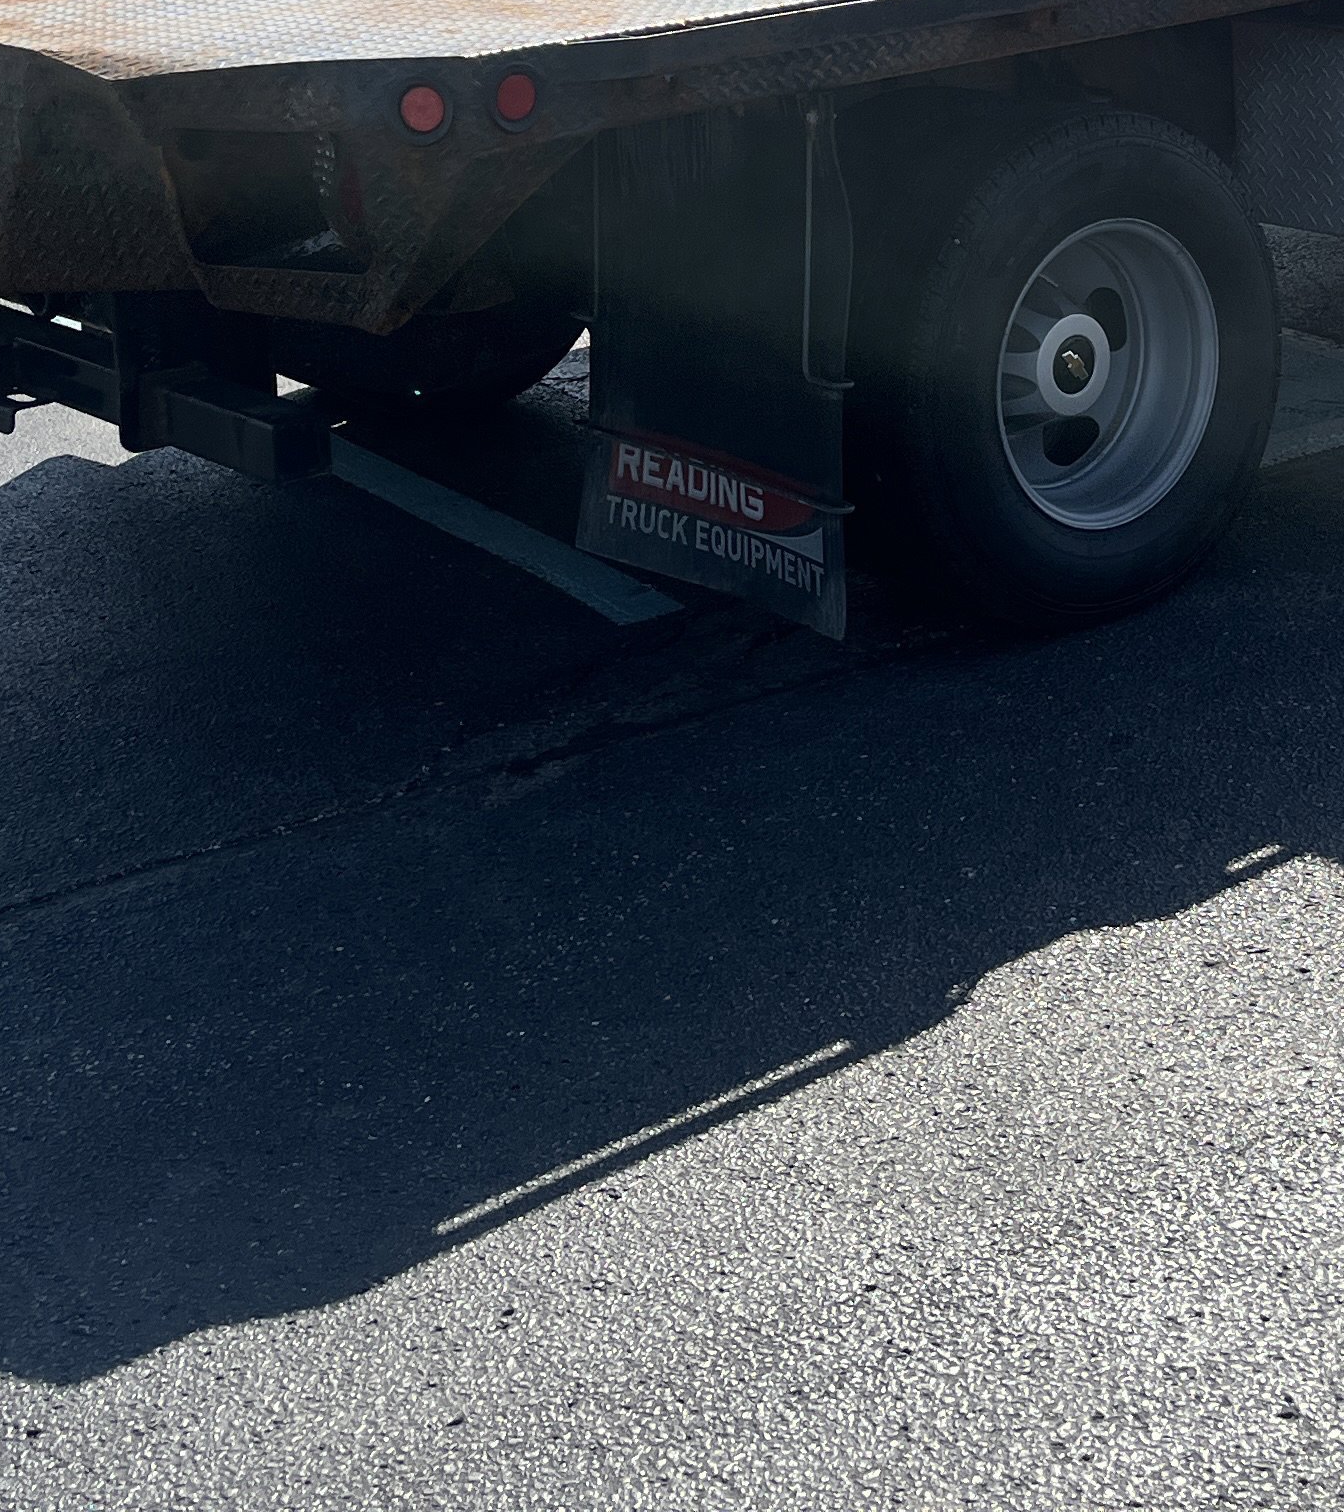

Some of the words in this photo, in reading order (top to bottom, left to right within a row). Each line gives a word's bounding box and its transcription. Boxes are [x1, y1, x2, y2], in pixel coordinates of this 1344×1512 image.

[616, 441, 765, 522] READING
[607, 494, 689, 546] TRUCK
[695, 519, 825, 598] EQUIPMENT
